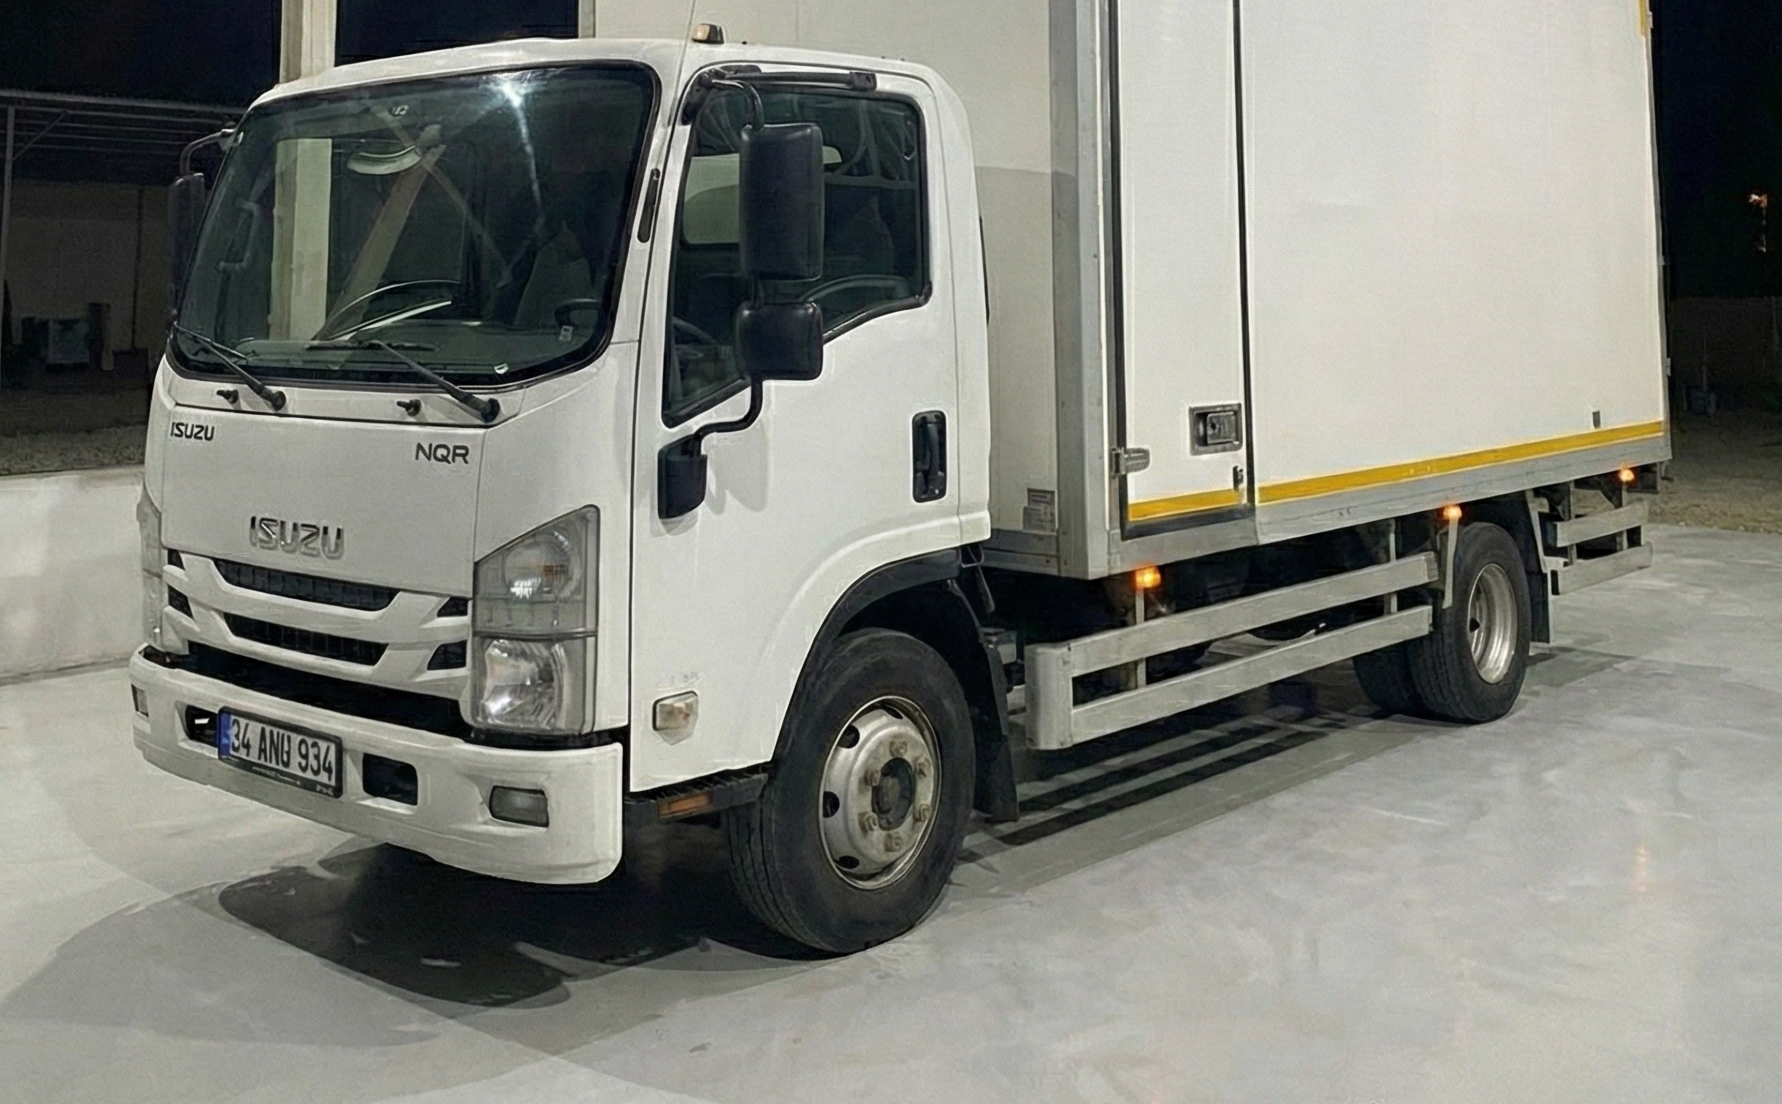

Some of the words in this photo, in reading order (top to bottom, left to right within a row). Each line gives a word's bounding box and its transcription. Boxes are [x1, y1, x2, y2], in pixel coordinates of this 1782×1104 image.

[170, 421, 215, 442] ISUZU
[415, 442, 470, 465] NQR
[250, 515, 345, 560] ISUZU
[231, 718, 251, 757] 34
[298, 738, 333, 782] 934
